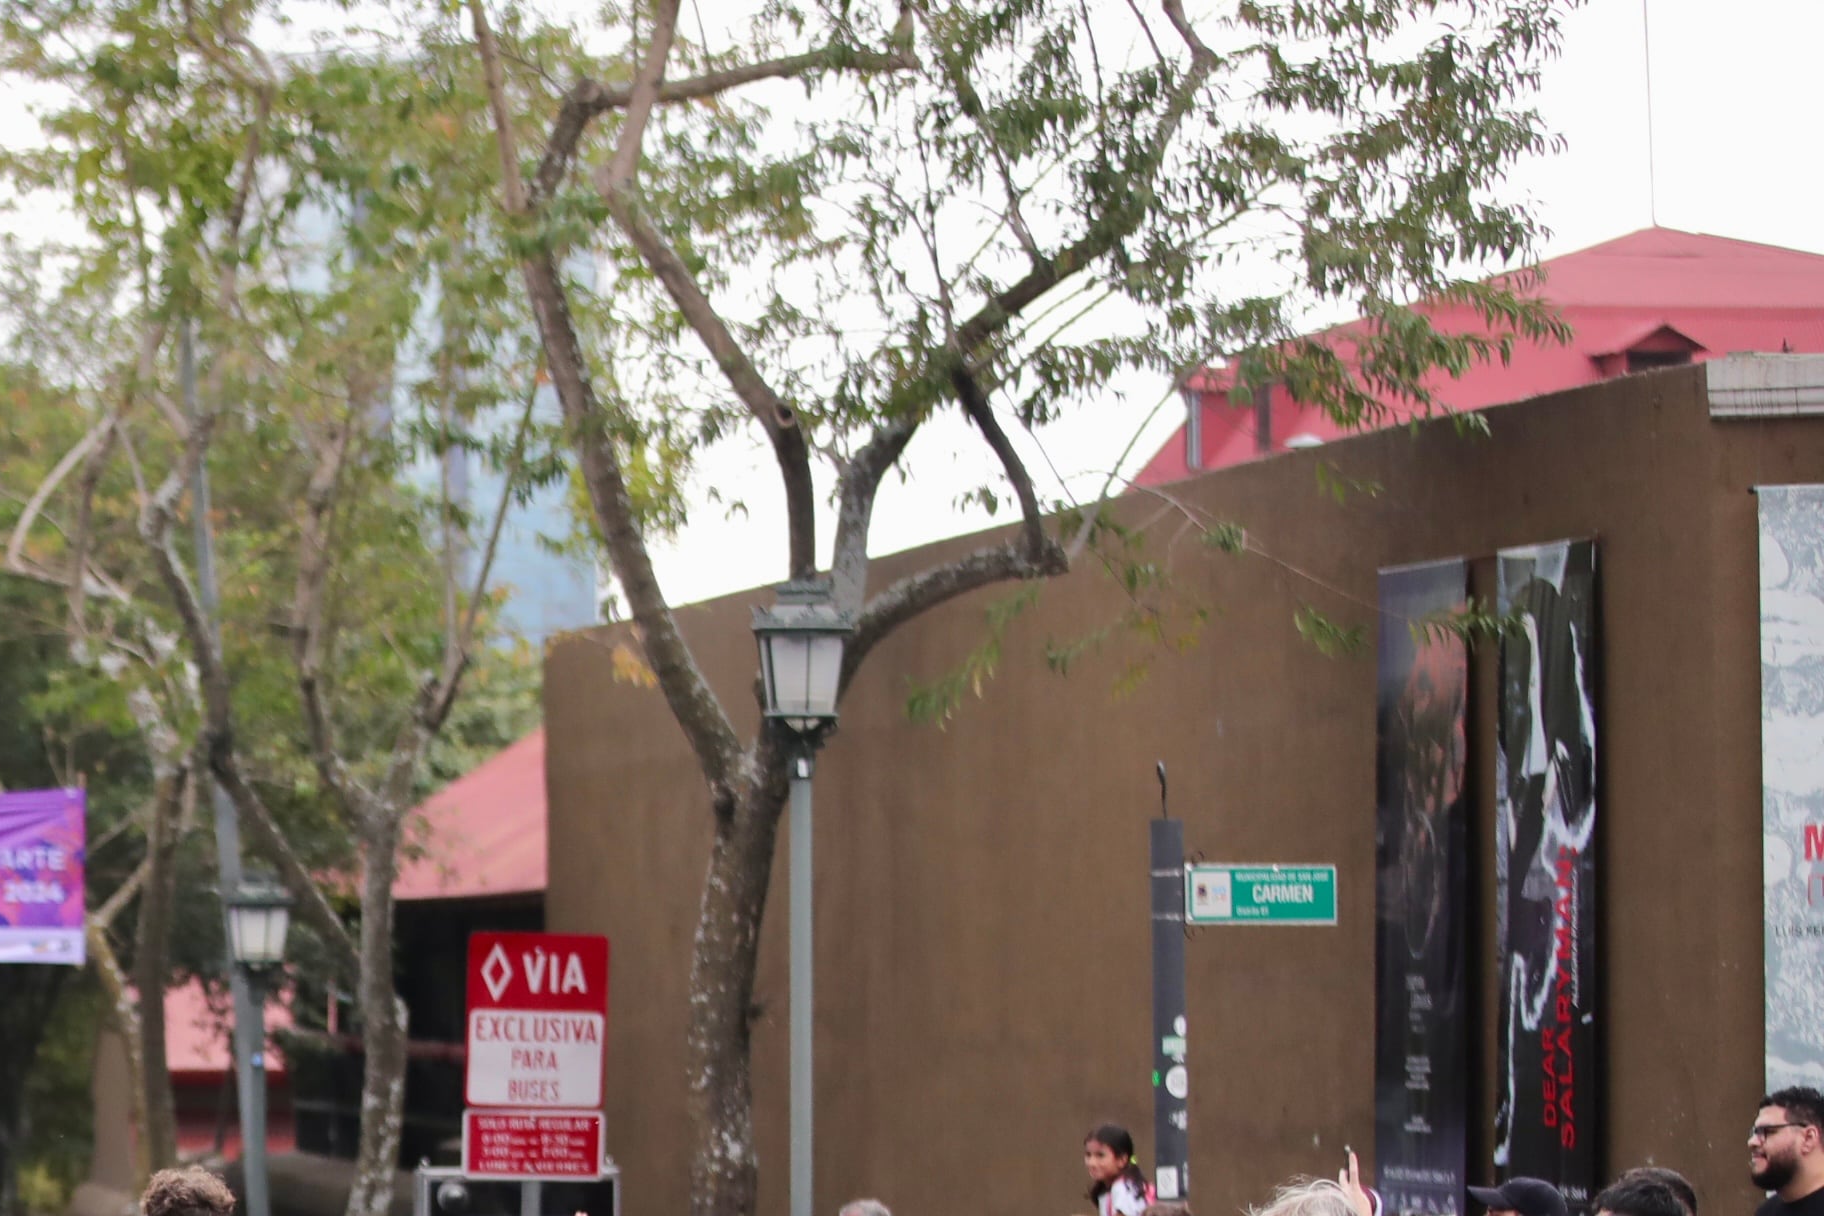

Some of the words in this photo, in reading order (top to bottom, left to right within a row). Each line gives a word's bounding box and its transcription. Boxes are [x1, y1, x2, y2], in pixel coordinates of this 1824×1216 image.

[1252, 884, 1314, 904] CARMEN
[523, 951, 588, 994] VIA
[476, 1014, 597, 1044] EXCLUSIVA
[511, 1048, 558, 1071] PARA
[1542, 1026, 1558, 1128] DEAR
[507, 1079, 561, 1102] BUSES
